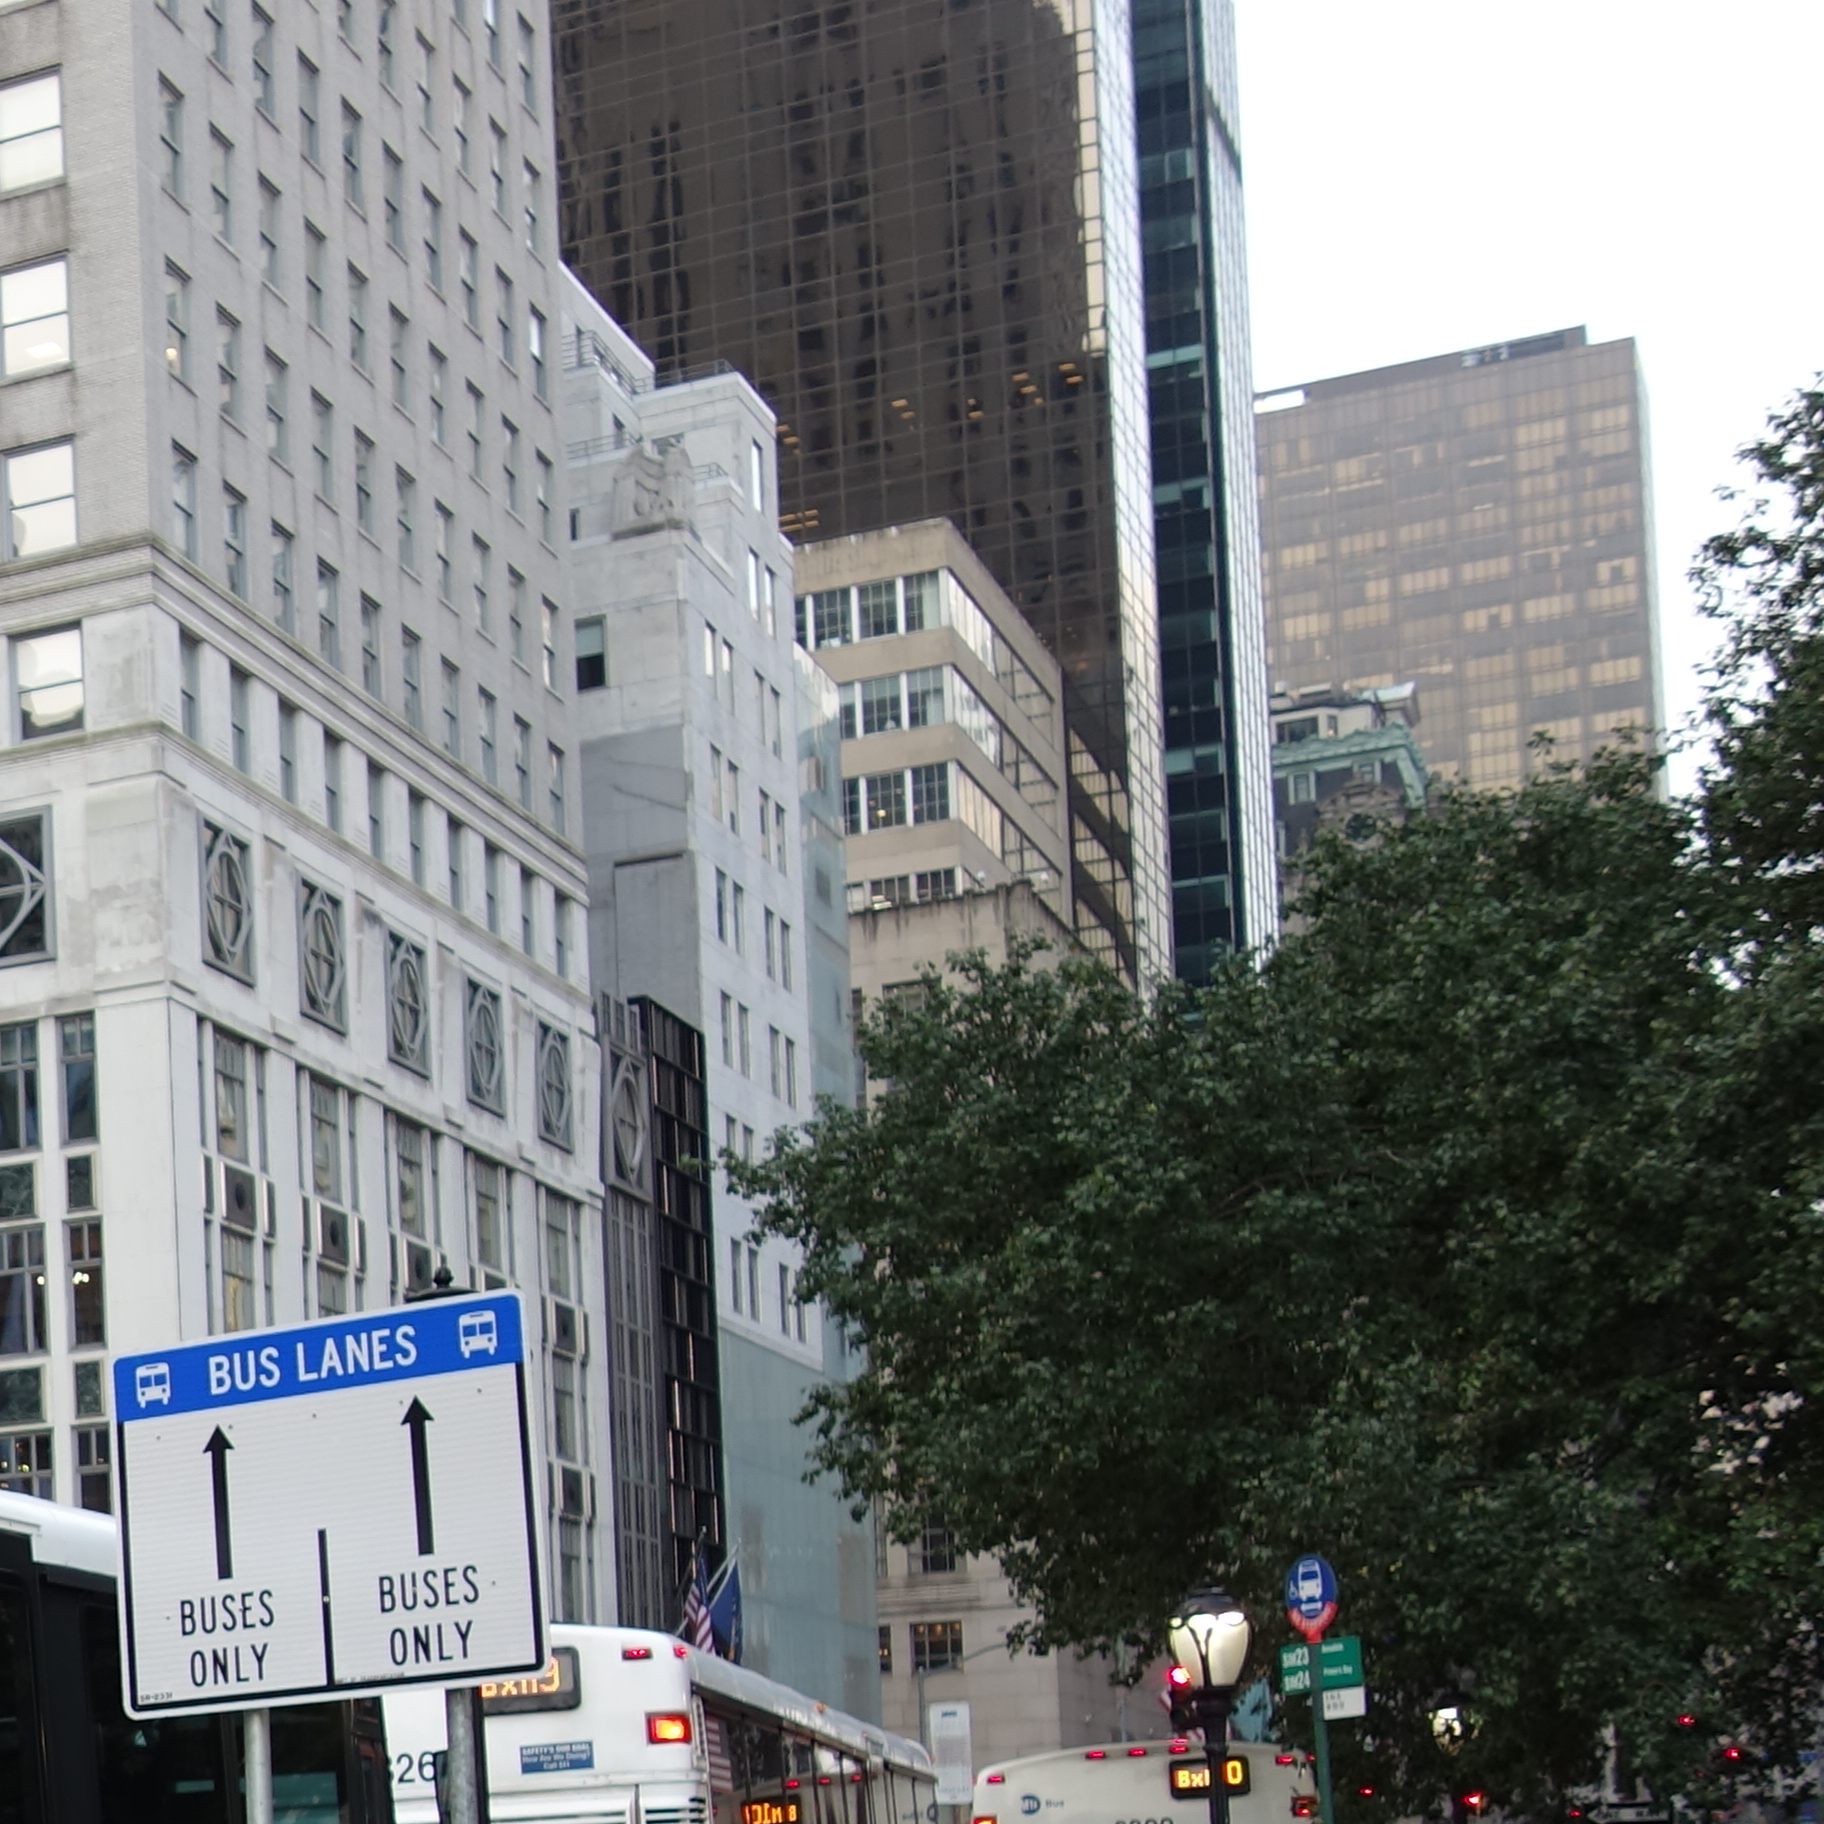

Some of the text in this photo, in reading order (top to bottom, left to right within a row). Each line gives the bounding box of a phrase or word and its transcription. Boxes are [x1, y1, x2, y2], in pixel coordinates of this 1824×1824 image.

[208, 1325, 418, 1395] BUS LANES
[179, 1589, 275, 1637] BUSES
[379, 1565, 480, 1614] BUSES
[190, 1643, 269, 1688] ONLY
[390, 1620, 474, 1666] ONLY
